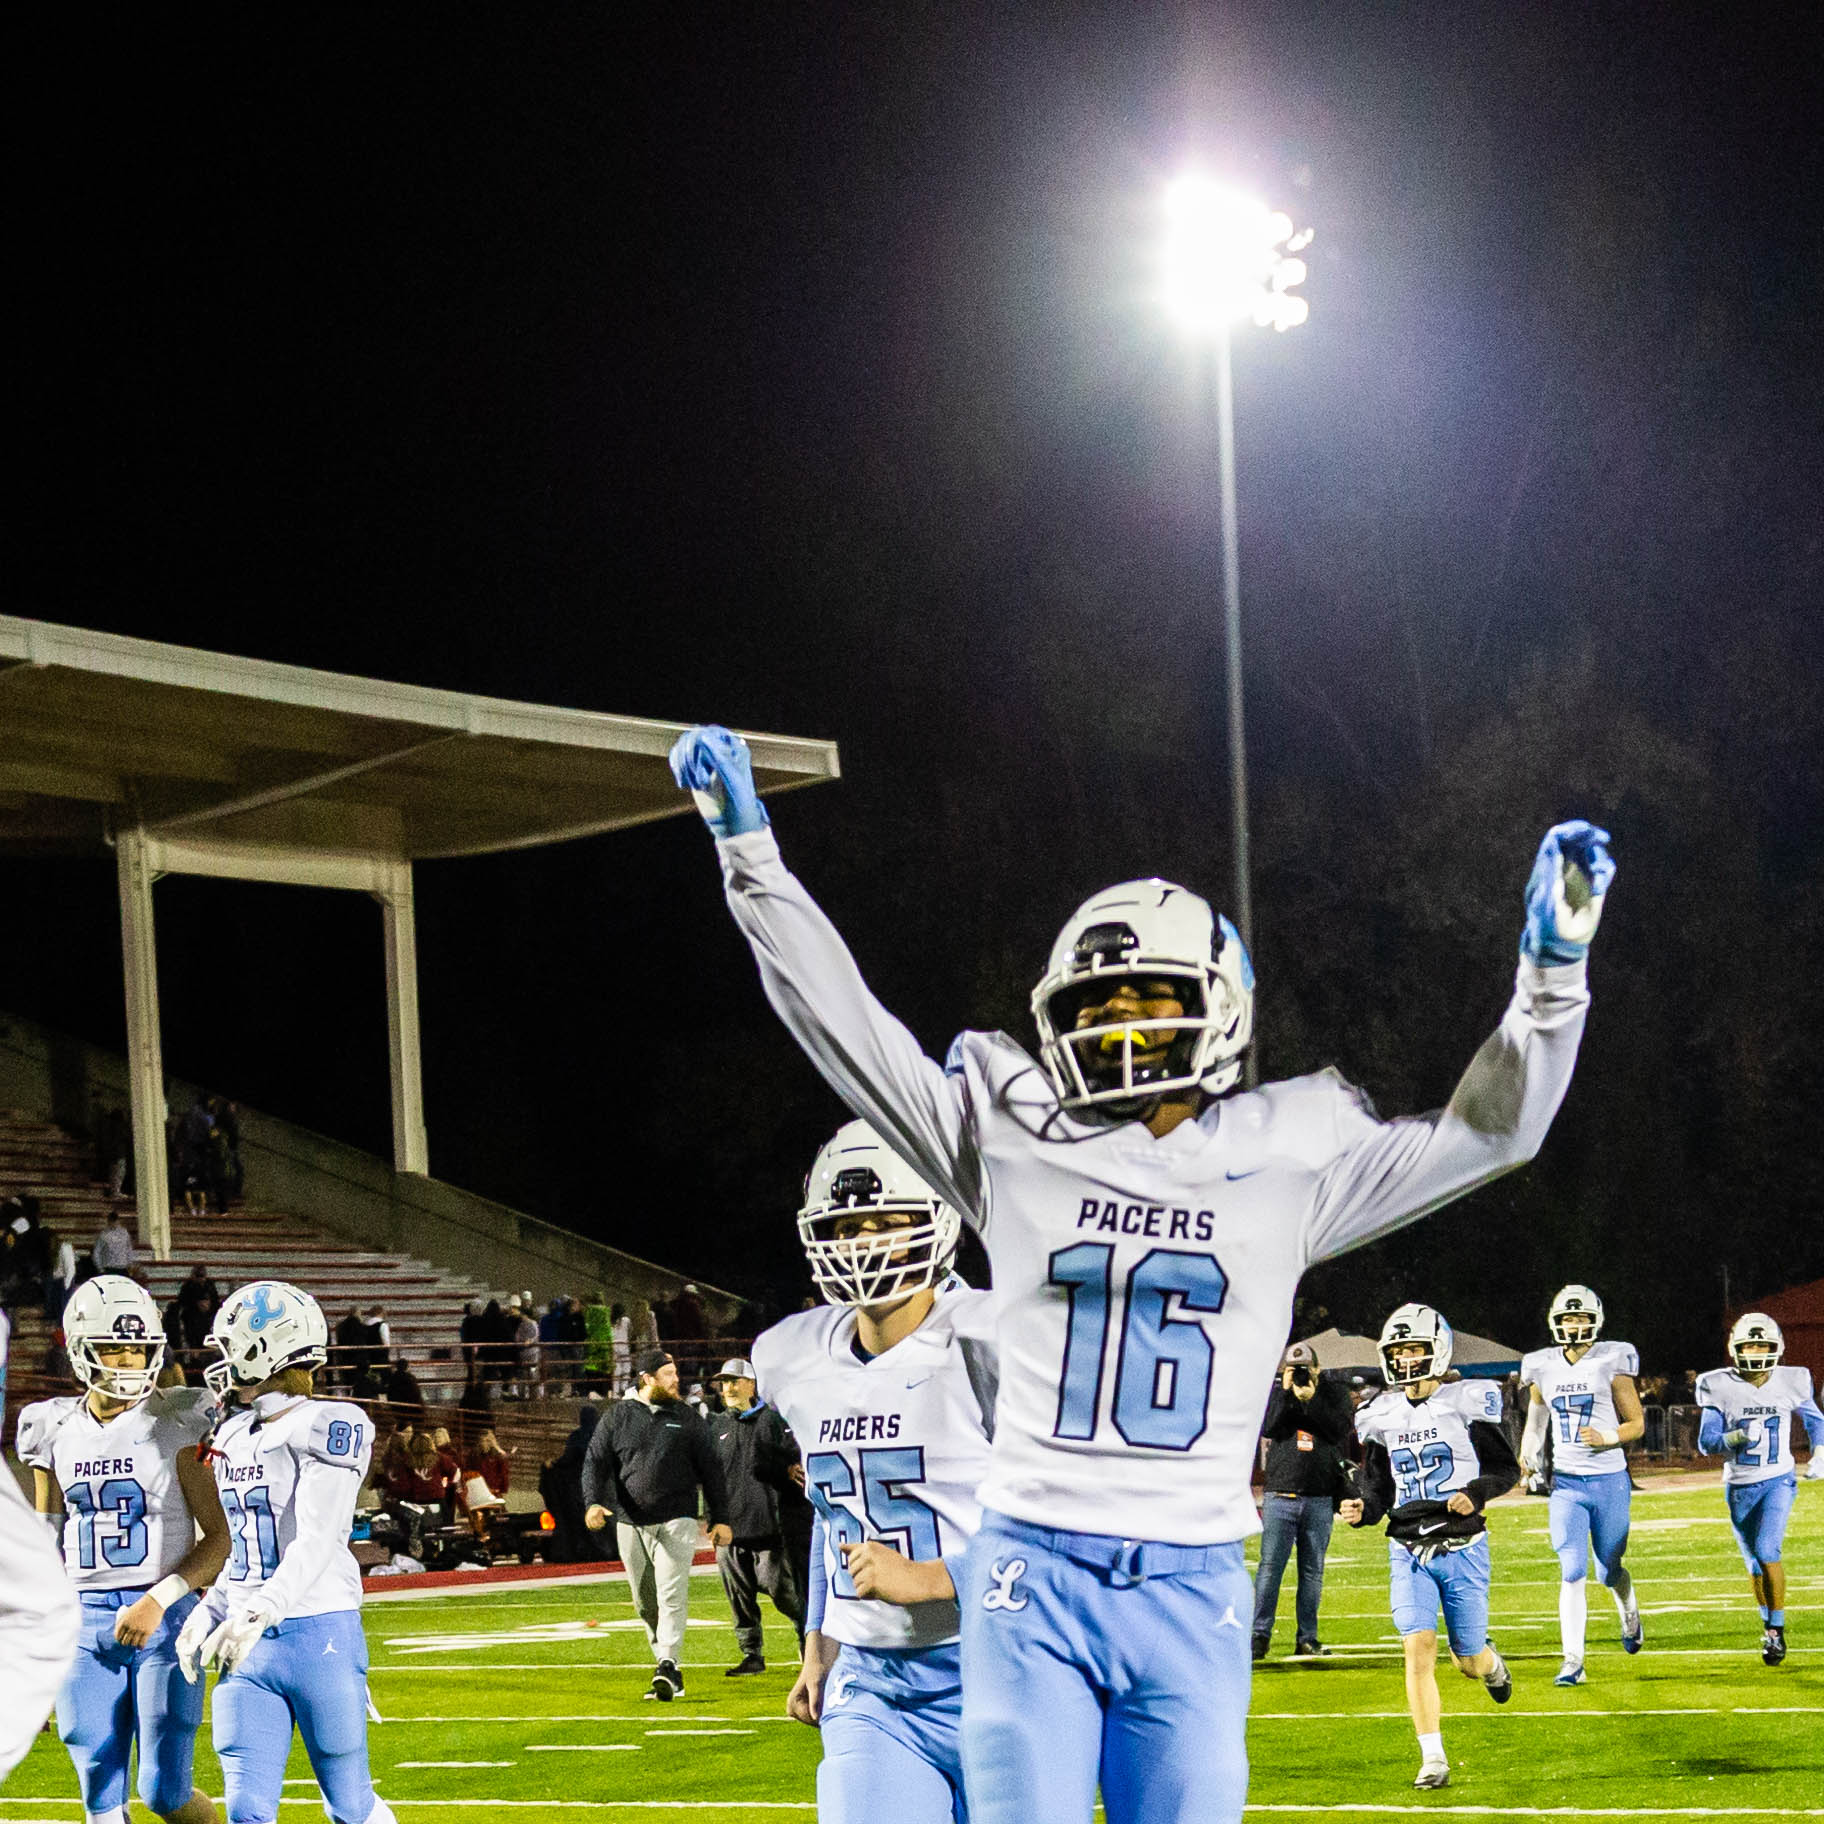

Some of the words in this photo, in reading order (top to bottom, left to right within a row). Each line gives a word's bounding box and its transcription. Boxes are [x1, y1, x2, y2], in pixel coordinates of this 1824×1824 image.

[1077, 1198, 1216, 1241] PACERS
[1049, 1240, 1229, 1451] 16
[327, 1420, 364, 1458] 81
[819, 1414, 901, 1443] PACERS
[1398, 1428, 1438, 1445] PACERS
[1552, 1393, 1594, 1443] 17
[1736, 1416, 1780, 1467] 21
[74, 1457, 134, 1478] PACERS
[1390, 1441, 1459, 1507] 32
[64, 1478, 149, 1570] 13
[806, 1445, 942, 1600] 65
